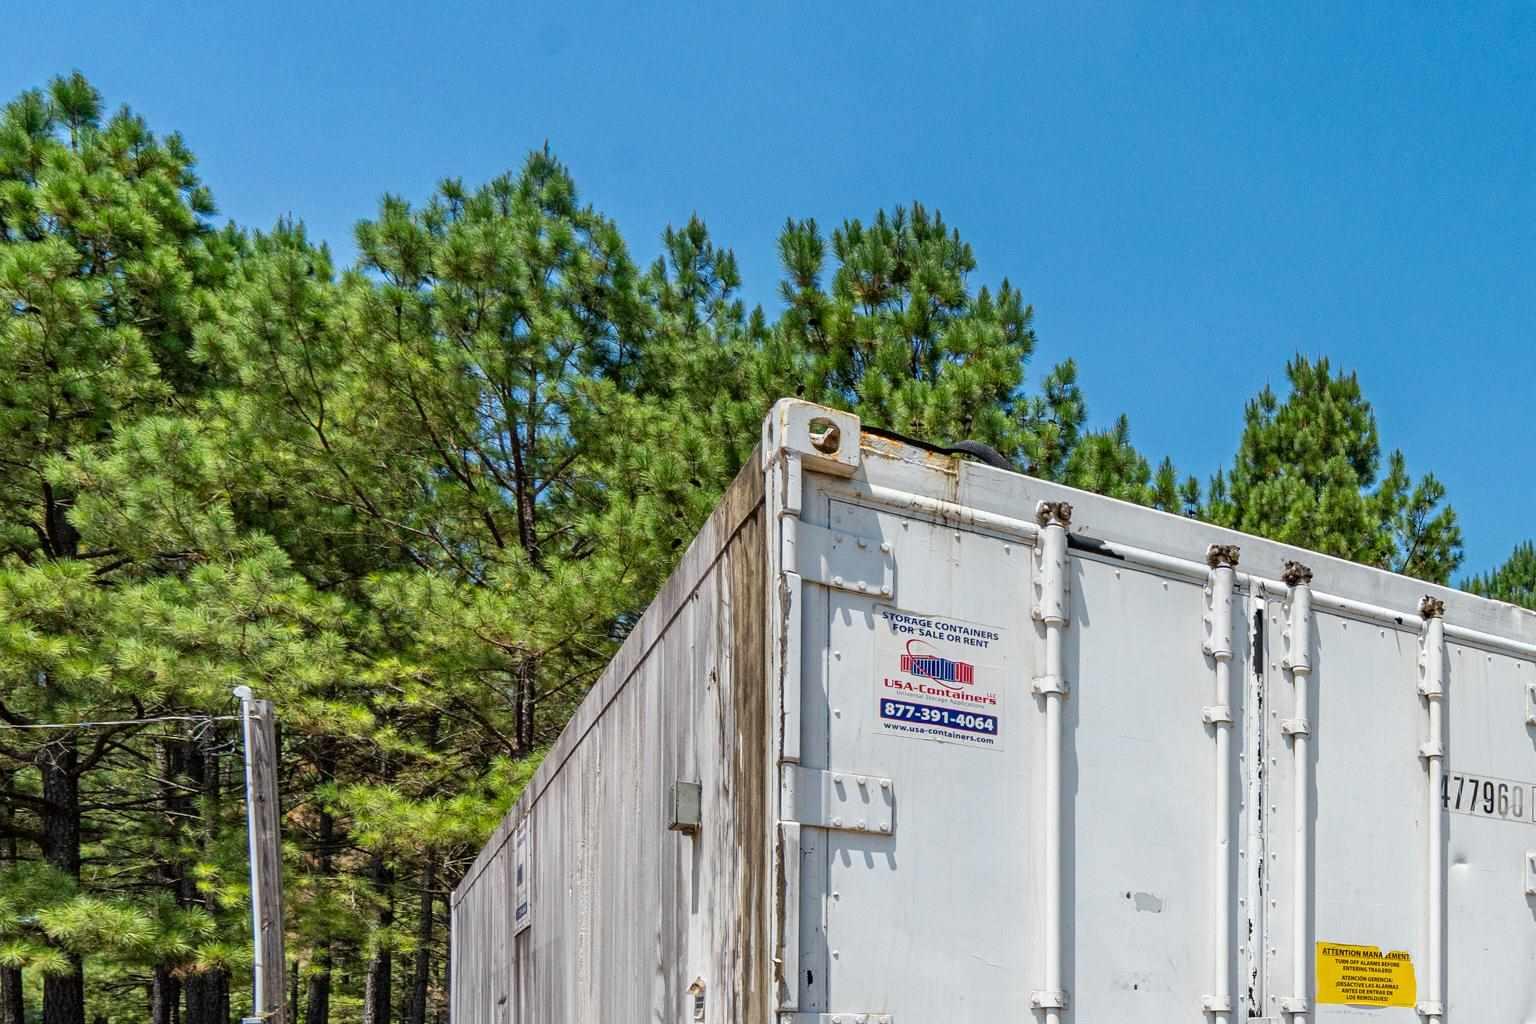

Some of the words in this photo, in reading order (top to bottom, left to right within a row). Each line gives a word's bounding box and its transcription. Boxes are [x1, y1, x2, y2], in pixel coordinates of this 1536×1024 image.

[882, 611, 933, 628] STORAGE
[935, 622, 999, 640] CONTAINERS
[893, 623, 914, 635] FOR
[919, 628, 945, 640] SALE
[946, 633, 961, 643] OR
[963, 637, 989, 648] RENT
[884, 678, 997, 705] USA-Containers
[884, 702, 994, 731] 877-391-4064
[883, 722, 994, 744] www.usa-containers.com
[1322, 948, 1361, 958] ATTENTION
[1362, 950, 1410, 961] MANAEMENT
